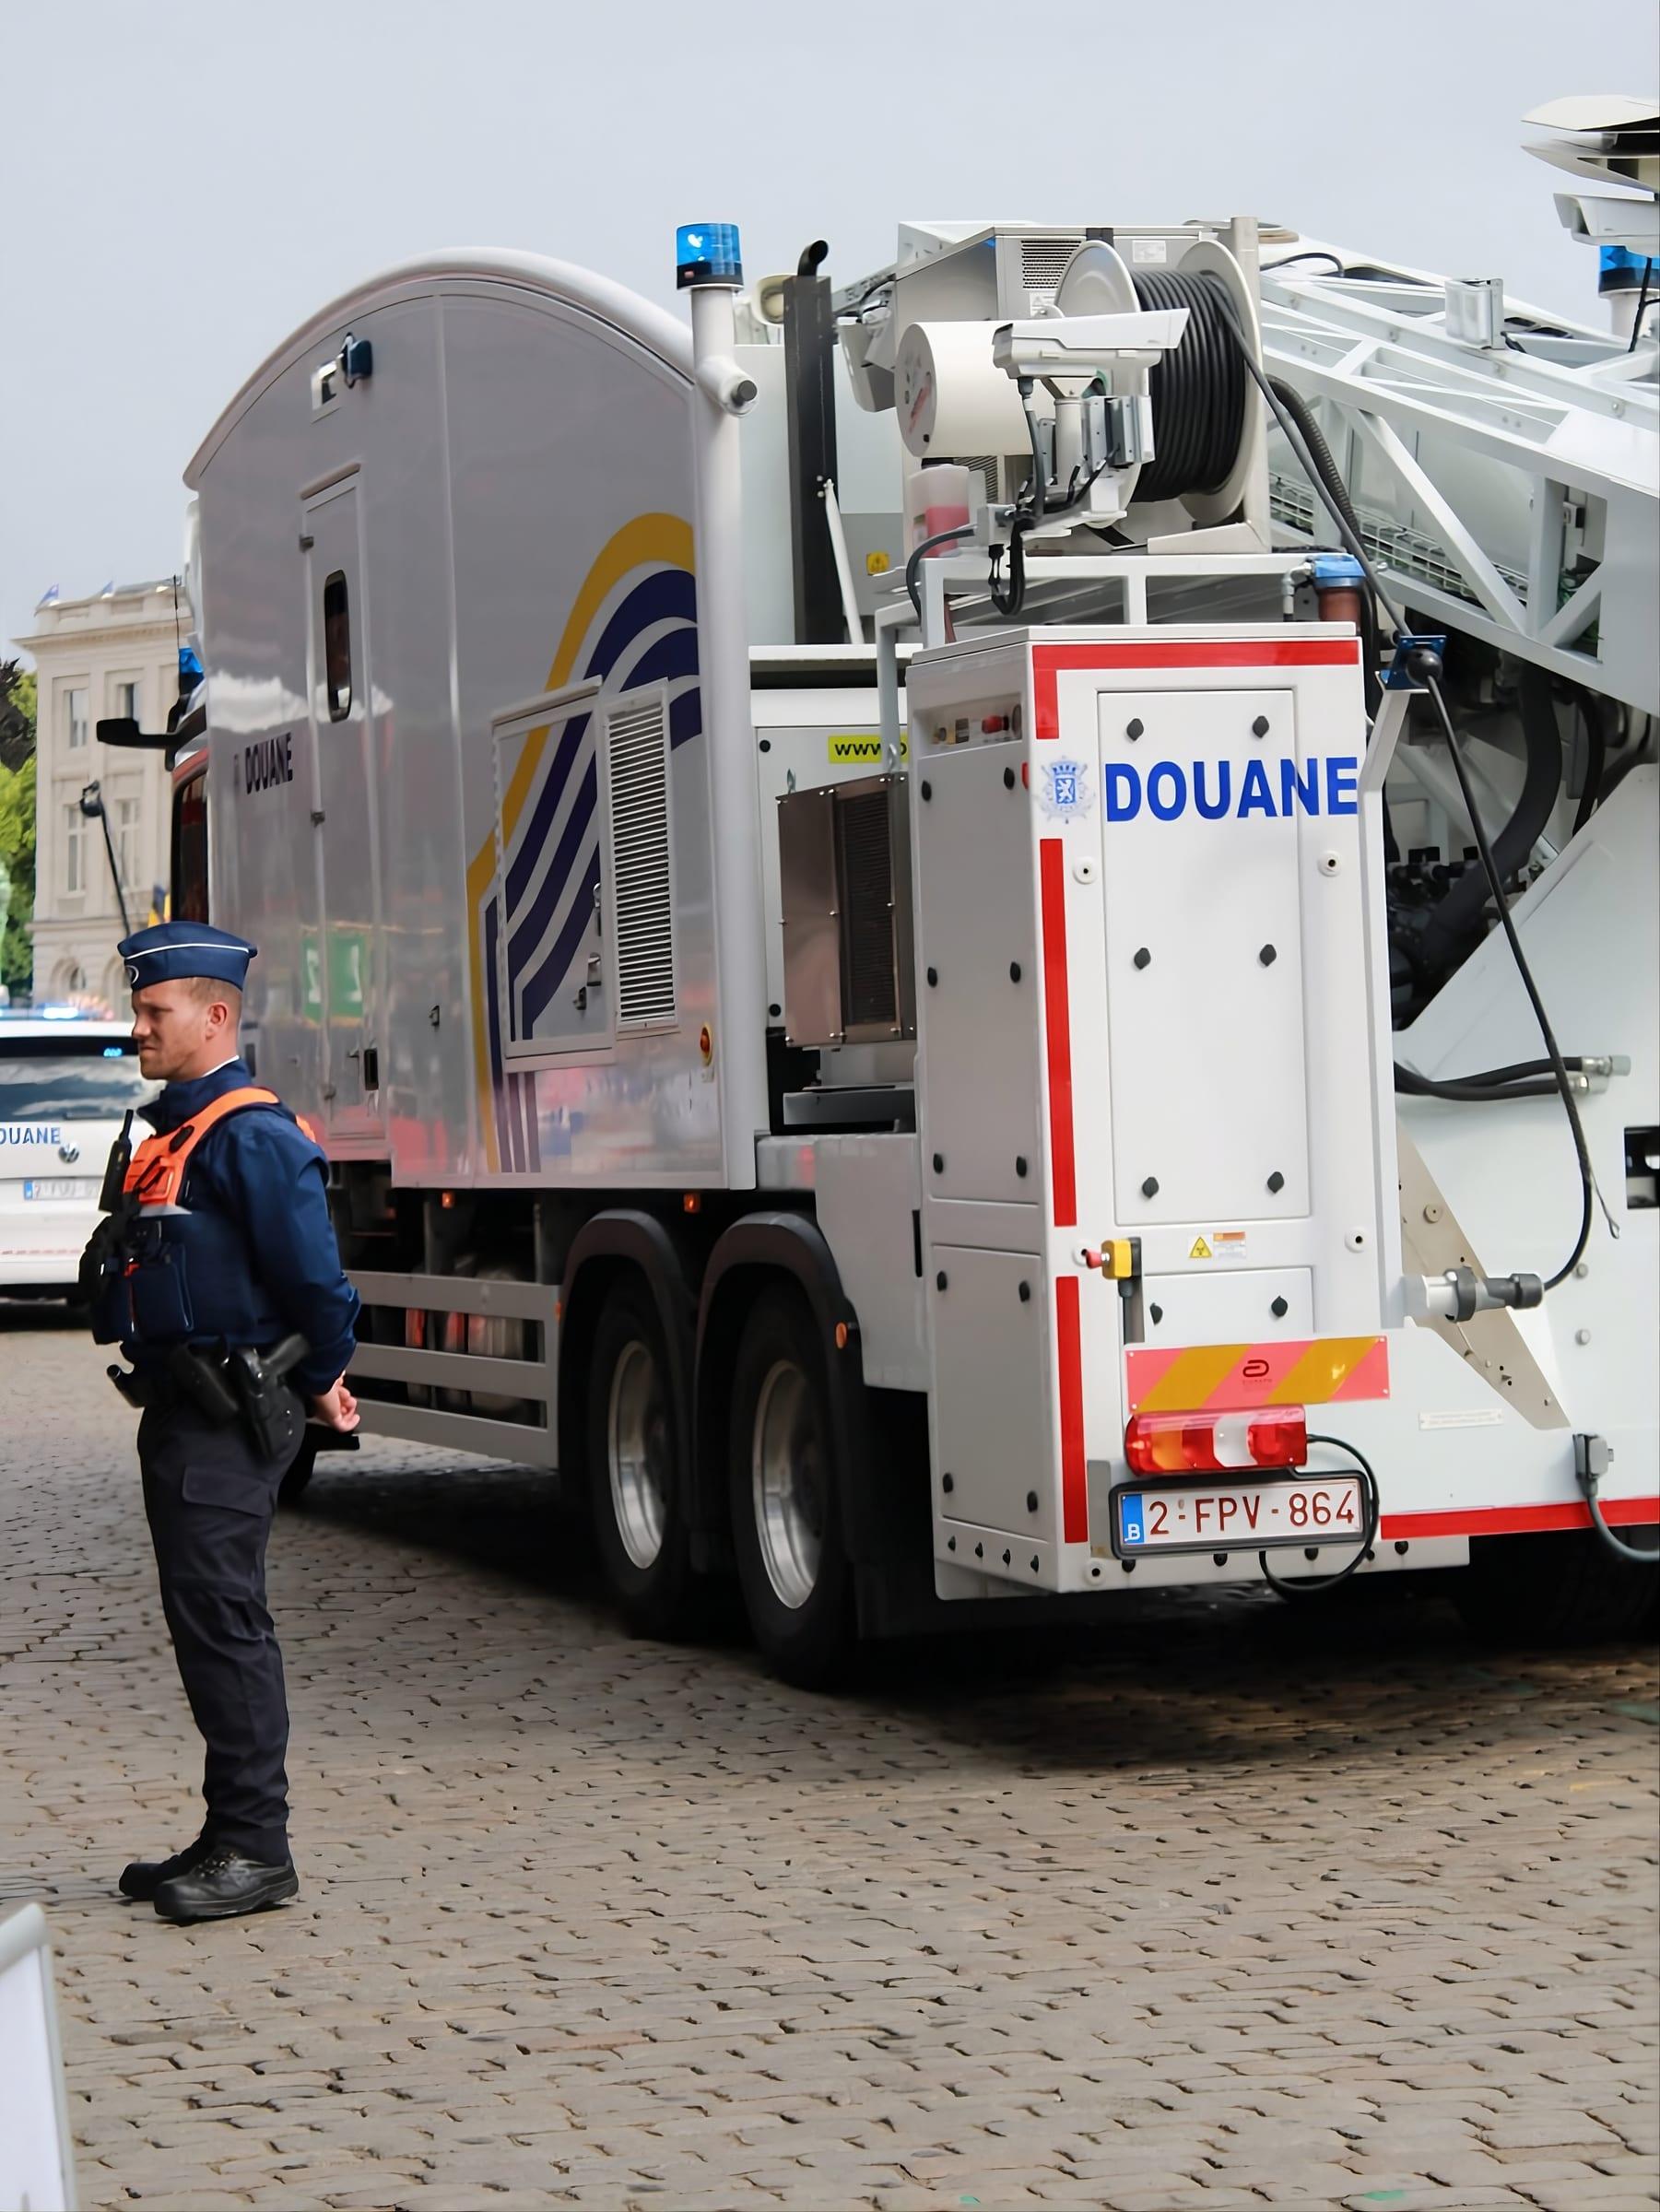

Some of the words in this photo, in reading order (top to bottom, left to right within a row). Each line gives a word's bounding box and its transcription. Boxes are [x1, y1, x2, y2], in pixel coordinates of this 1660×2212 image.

[245, 732, 293, 794] DOUANE
[1105, 757, 1358, 822] DOUANE
[1127, 1524, 1140, 1540] B
